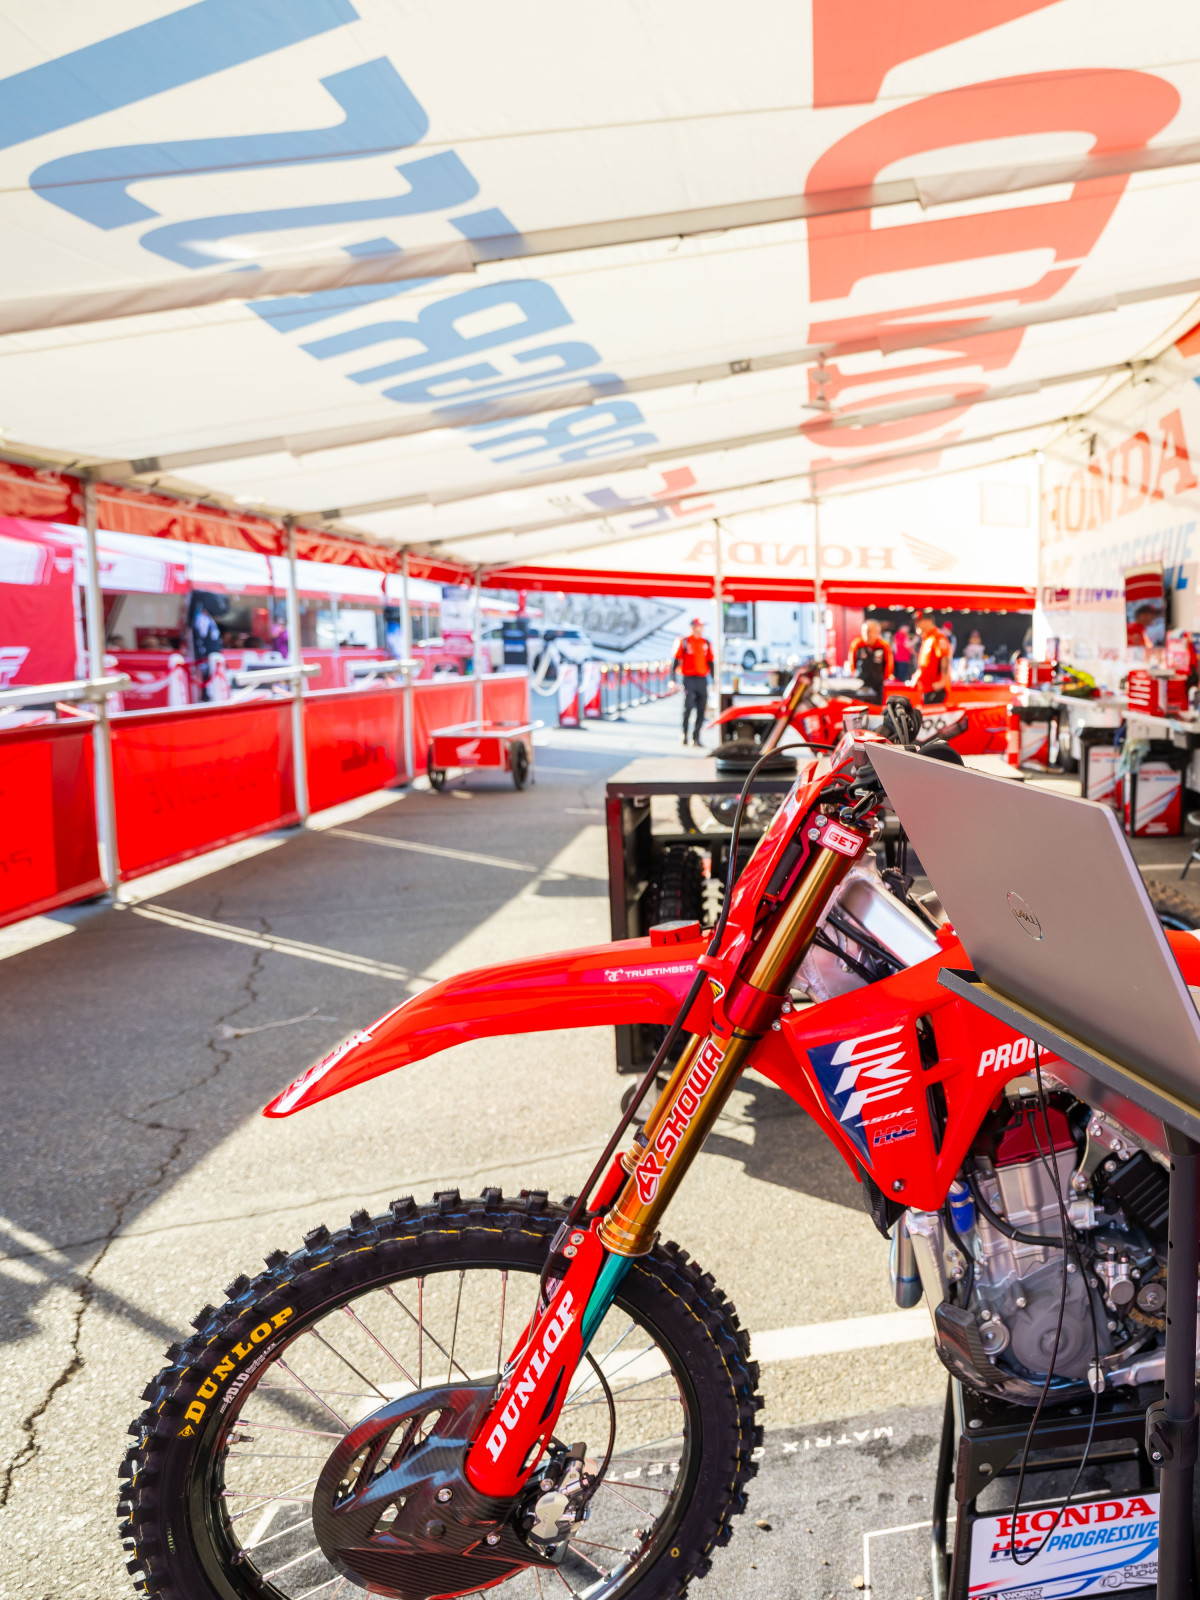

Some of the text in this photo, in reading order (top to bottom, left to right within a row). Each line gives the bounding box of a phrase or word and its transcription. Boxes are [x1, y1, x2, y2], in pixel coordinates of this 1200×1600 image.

[827, 830, 859, 852] GET
[625, 964, 694, 979] TRUETIMBER
[830, 1025, 913, 1122] CRF
[655, 1039, 726, 1162] SHOWA
[184, 1306, 293, 1424] DUNLOP
[485, 1289, 577, 1464] DUNLOP
[782, 1425, 894, 1454] MATRIX
[996, 1496, 1156, 1538] HONDA
[1046, 1520, 1159, 1553] PROGRESSIVE
